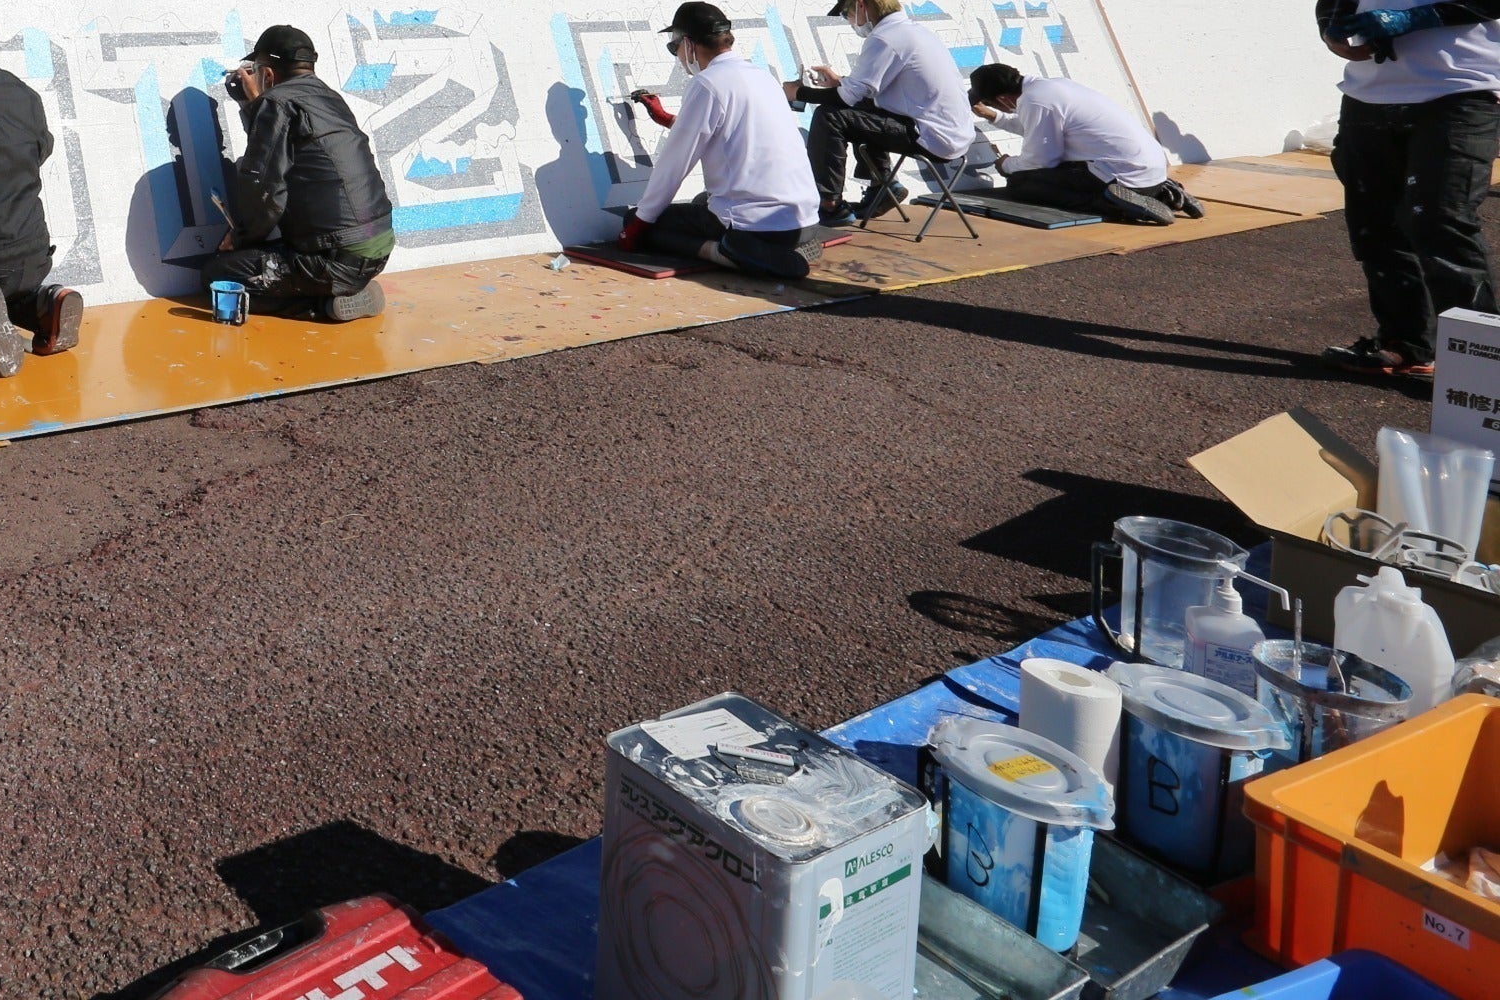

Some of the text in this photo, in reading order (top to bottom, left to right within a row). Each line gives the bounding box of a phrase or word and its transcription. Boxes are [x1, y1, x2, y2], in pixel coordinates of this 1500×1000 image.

[1147, 756, 1180, 816] B
[858, 843, 894, 869] ALESCO
[964, 822, 995, 886] B
[1424, 913, 1465, 941] No.7
